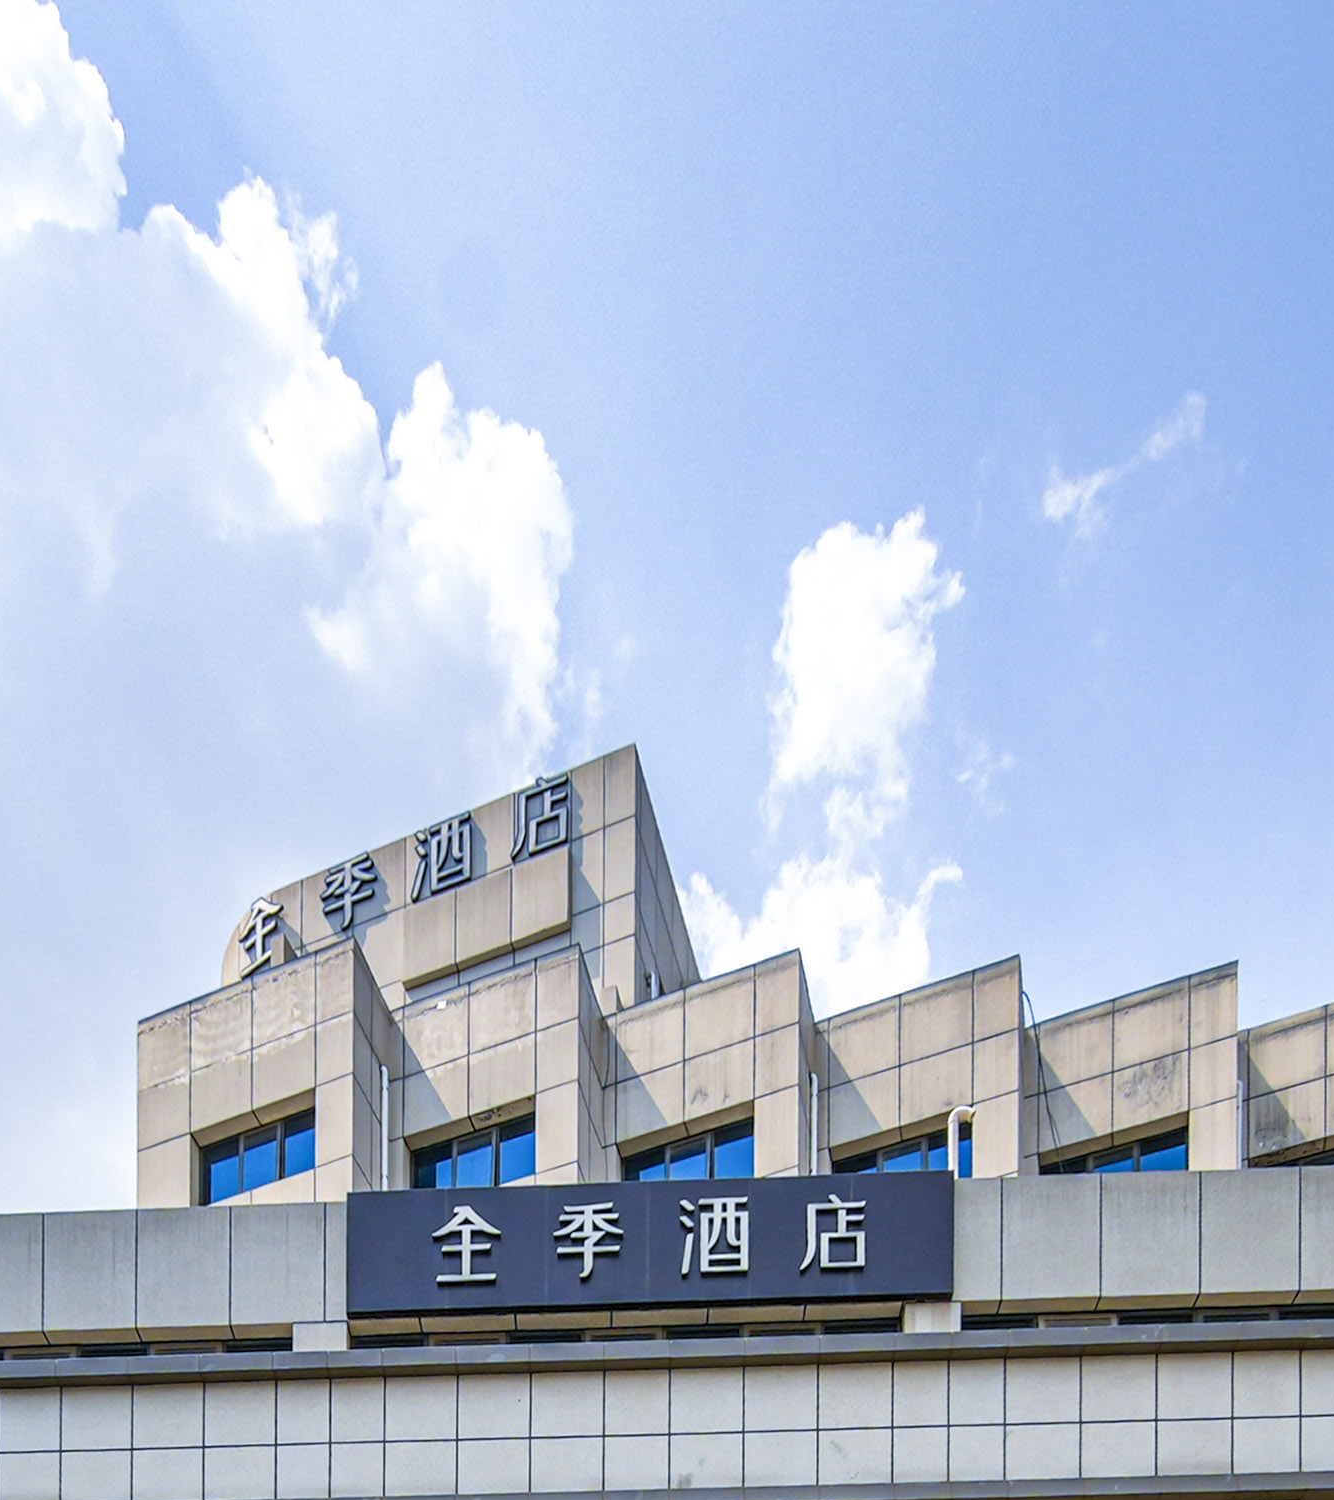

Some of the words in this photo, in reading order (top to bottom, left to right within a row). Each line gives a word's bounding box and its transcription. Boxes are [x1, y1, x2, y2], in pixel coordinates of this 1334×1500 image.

[238, 775, 571, 977] 全季酒店
[431, 1193, 868, 1285] 全季酒店
